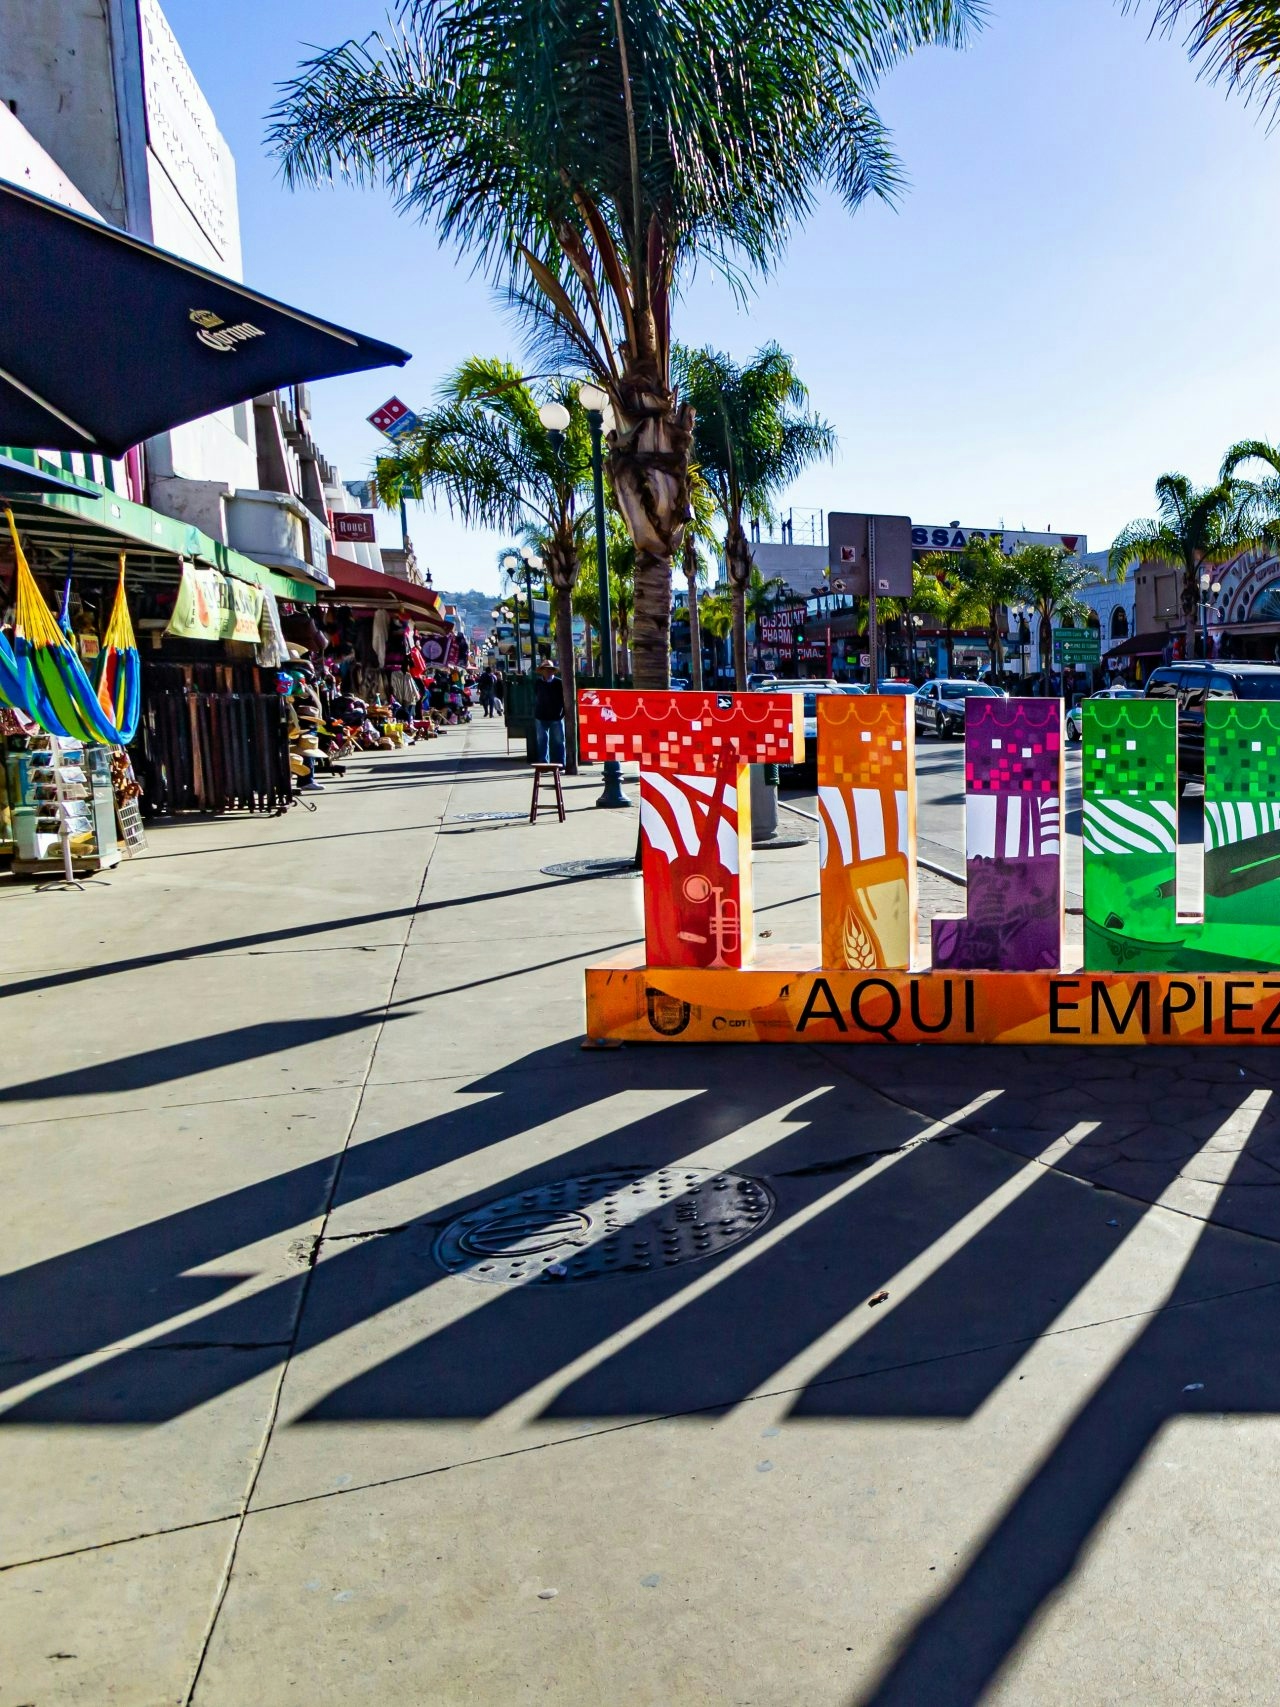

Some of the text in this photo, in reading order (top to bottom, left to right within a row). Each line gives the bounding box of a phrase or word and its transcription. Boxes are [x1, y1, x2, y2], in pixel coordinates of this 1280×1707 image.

[196, 322, 265, 351] Corona
[340, 521, 368, 533] ROUGE
[762, 610, 805, 629] DISCOUNT
[795, 978, 975, 1042] AQUI
[728, 1019, 747, 1028] CDT
